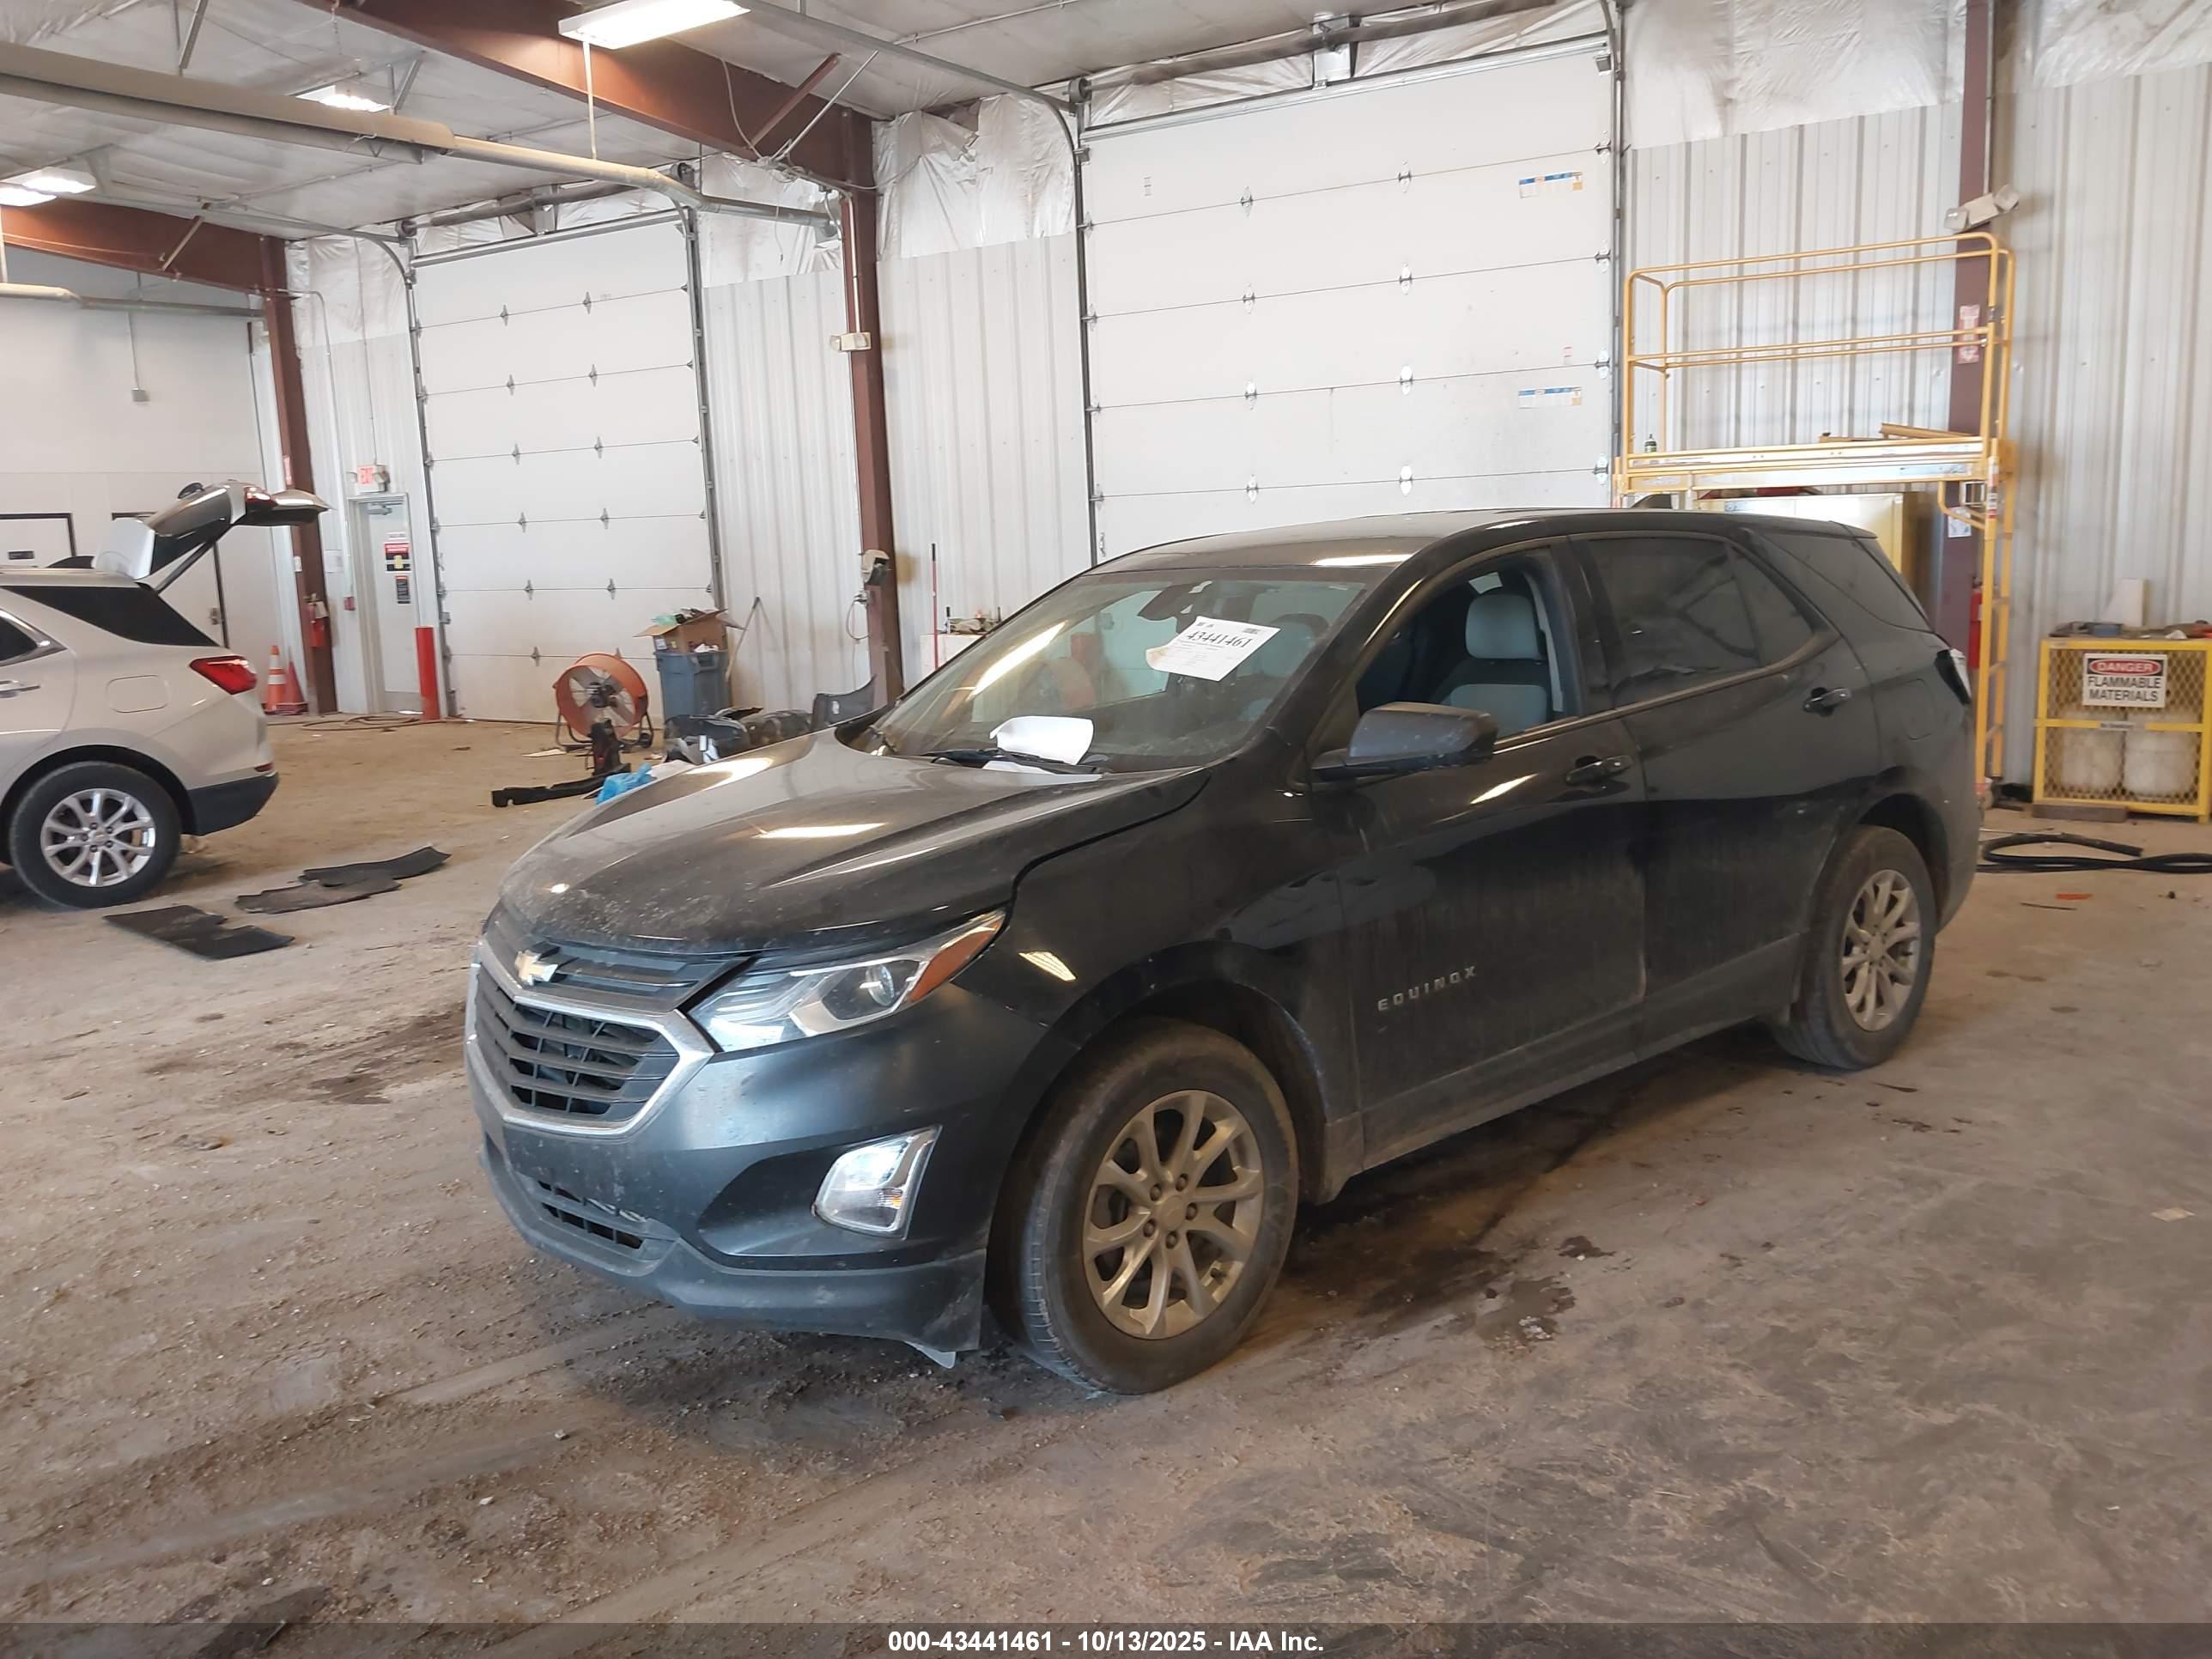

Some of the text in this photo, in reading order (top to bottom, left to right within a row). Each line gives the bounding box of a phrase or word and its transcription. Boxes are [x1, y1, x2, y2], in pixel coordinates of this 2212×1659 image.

[1187, 630, 1251, 648] 43441461
[2097, 661, 2154, 672] DANGER
[2087, 676, 2161, 689] FLAMMABLE
[2089, 689, 2158, 702] MATERIALS
[1377, 965, 1475, 1012] EQUINOX
